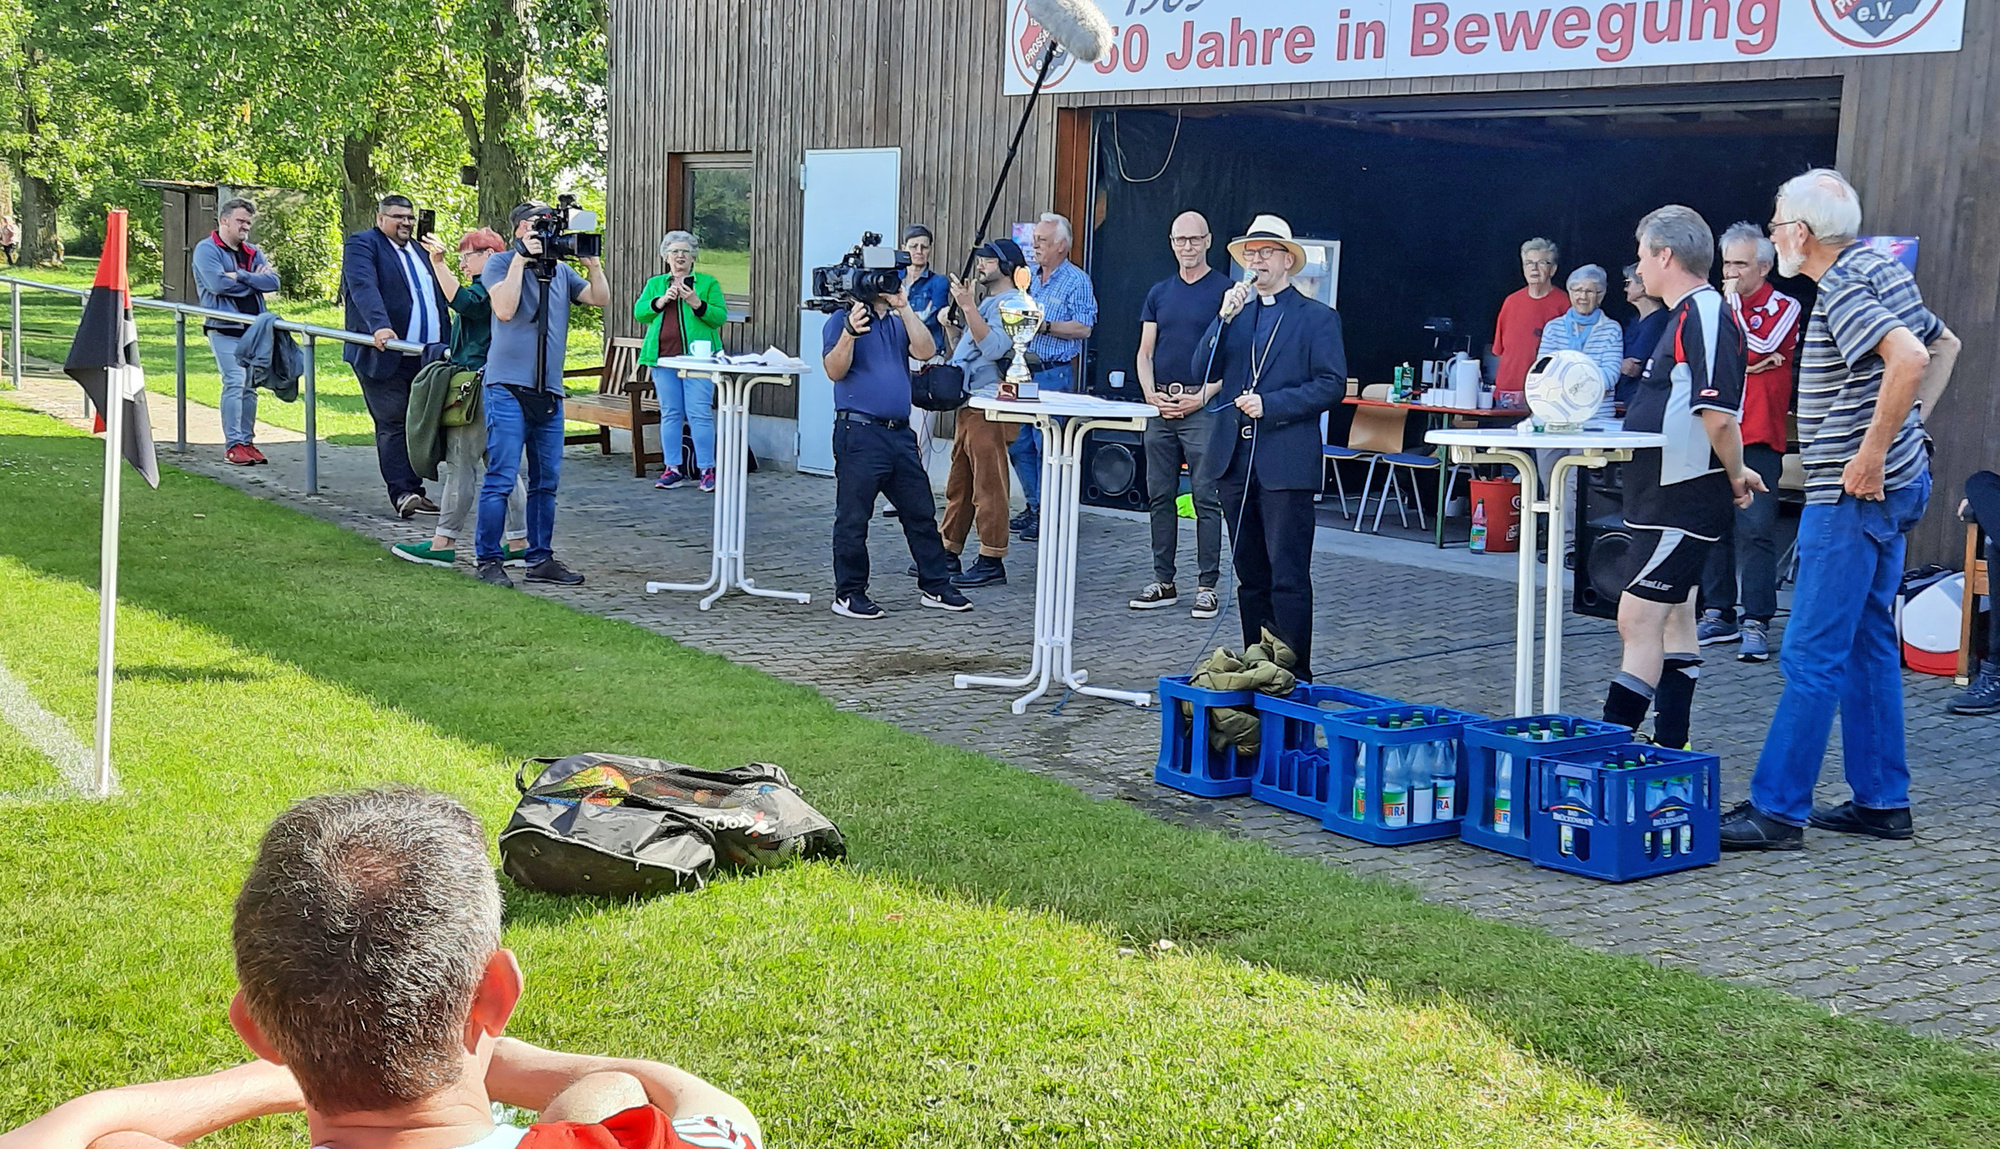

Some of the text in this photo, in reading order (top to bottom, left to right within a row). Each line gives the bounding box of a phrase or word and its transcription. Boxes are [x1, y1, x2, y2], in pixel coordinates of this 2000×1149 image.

[1857, 0, 1894, 21] e.V.
[1025, 29, 1051, 65] PROSSE
[1166, 17, 1315, 70] Jahre
[1336, 8, 1386, 61] in
[1410, 0, 1780, 62] Bewegung
[699, 812, 755, 833] precis
